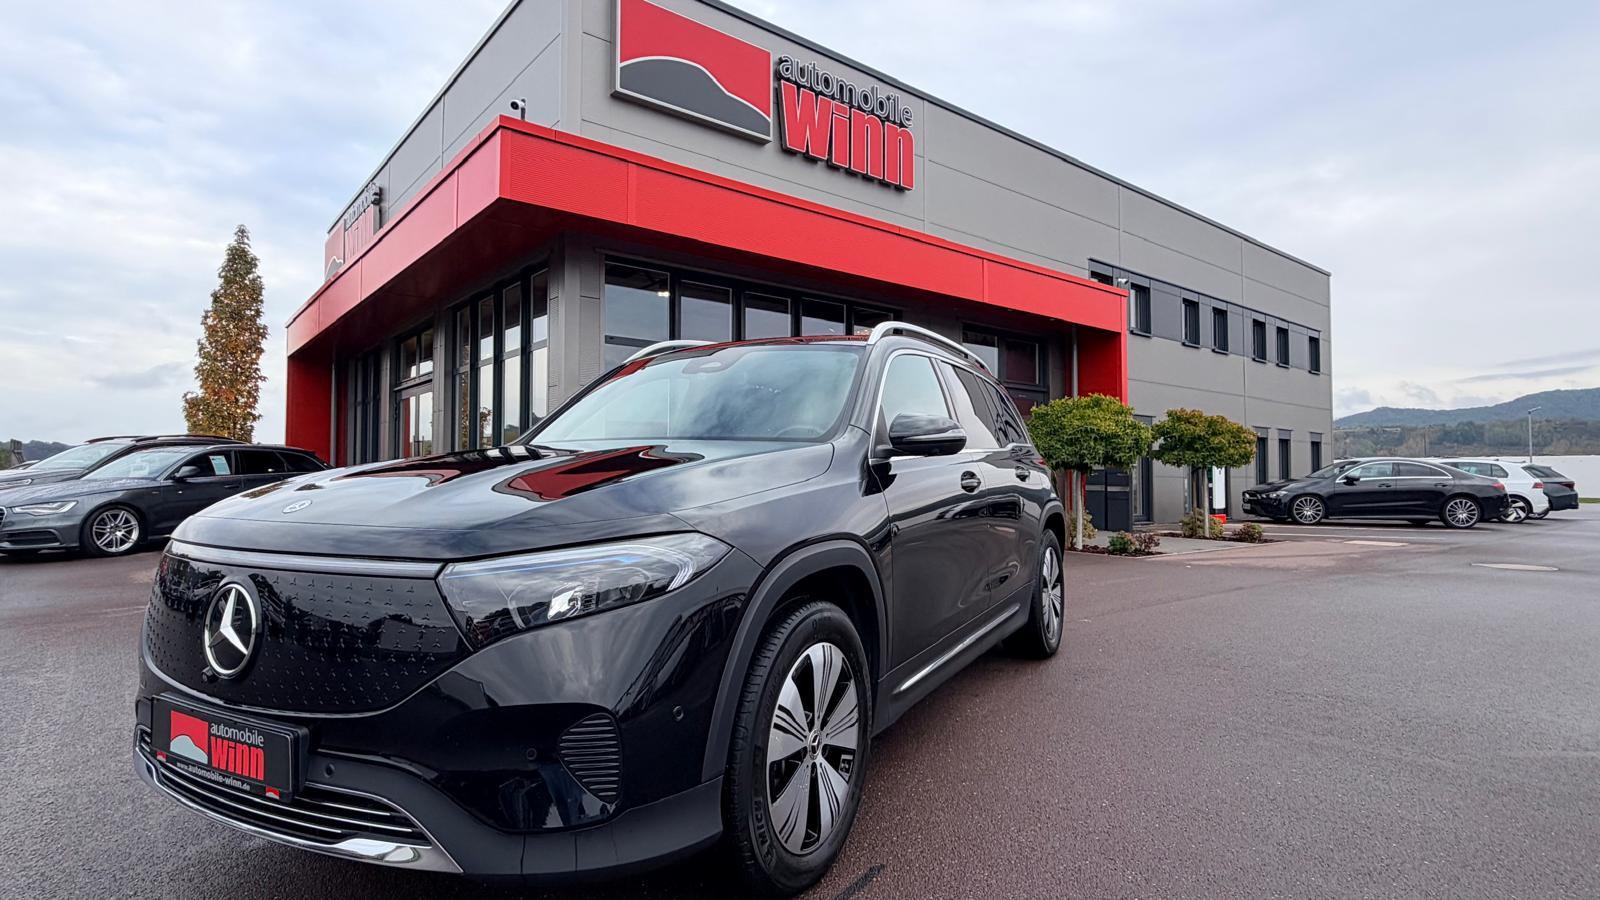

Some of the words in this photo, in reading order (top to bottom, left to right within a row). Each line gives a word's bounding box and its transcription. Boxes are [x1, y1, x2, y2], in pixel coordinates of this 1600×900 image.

[779, 55, 913, 127] automobile
[210, 723, 264, 747] automobile
[177, 762, 251, 790] www.automobile-winn.de
